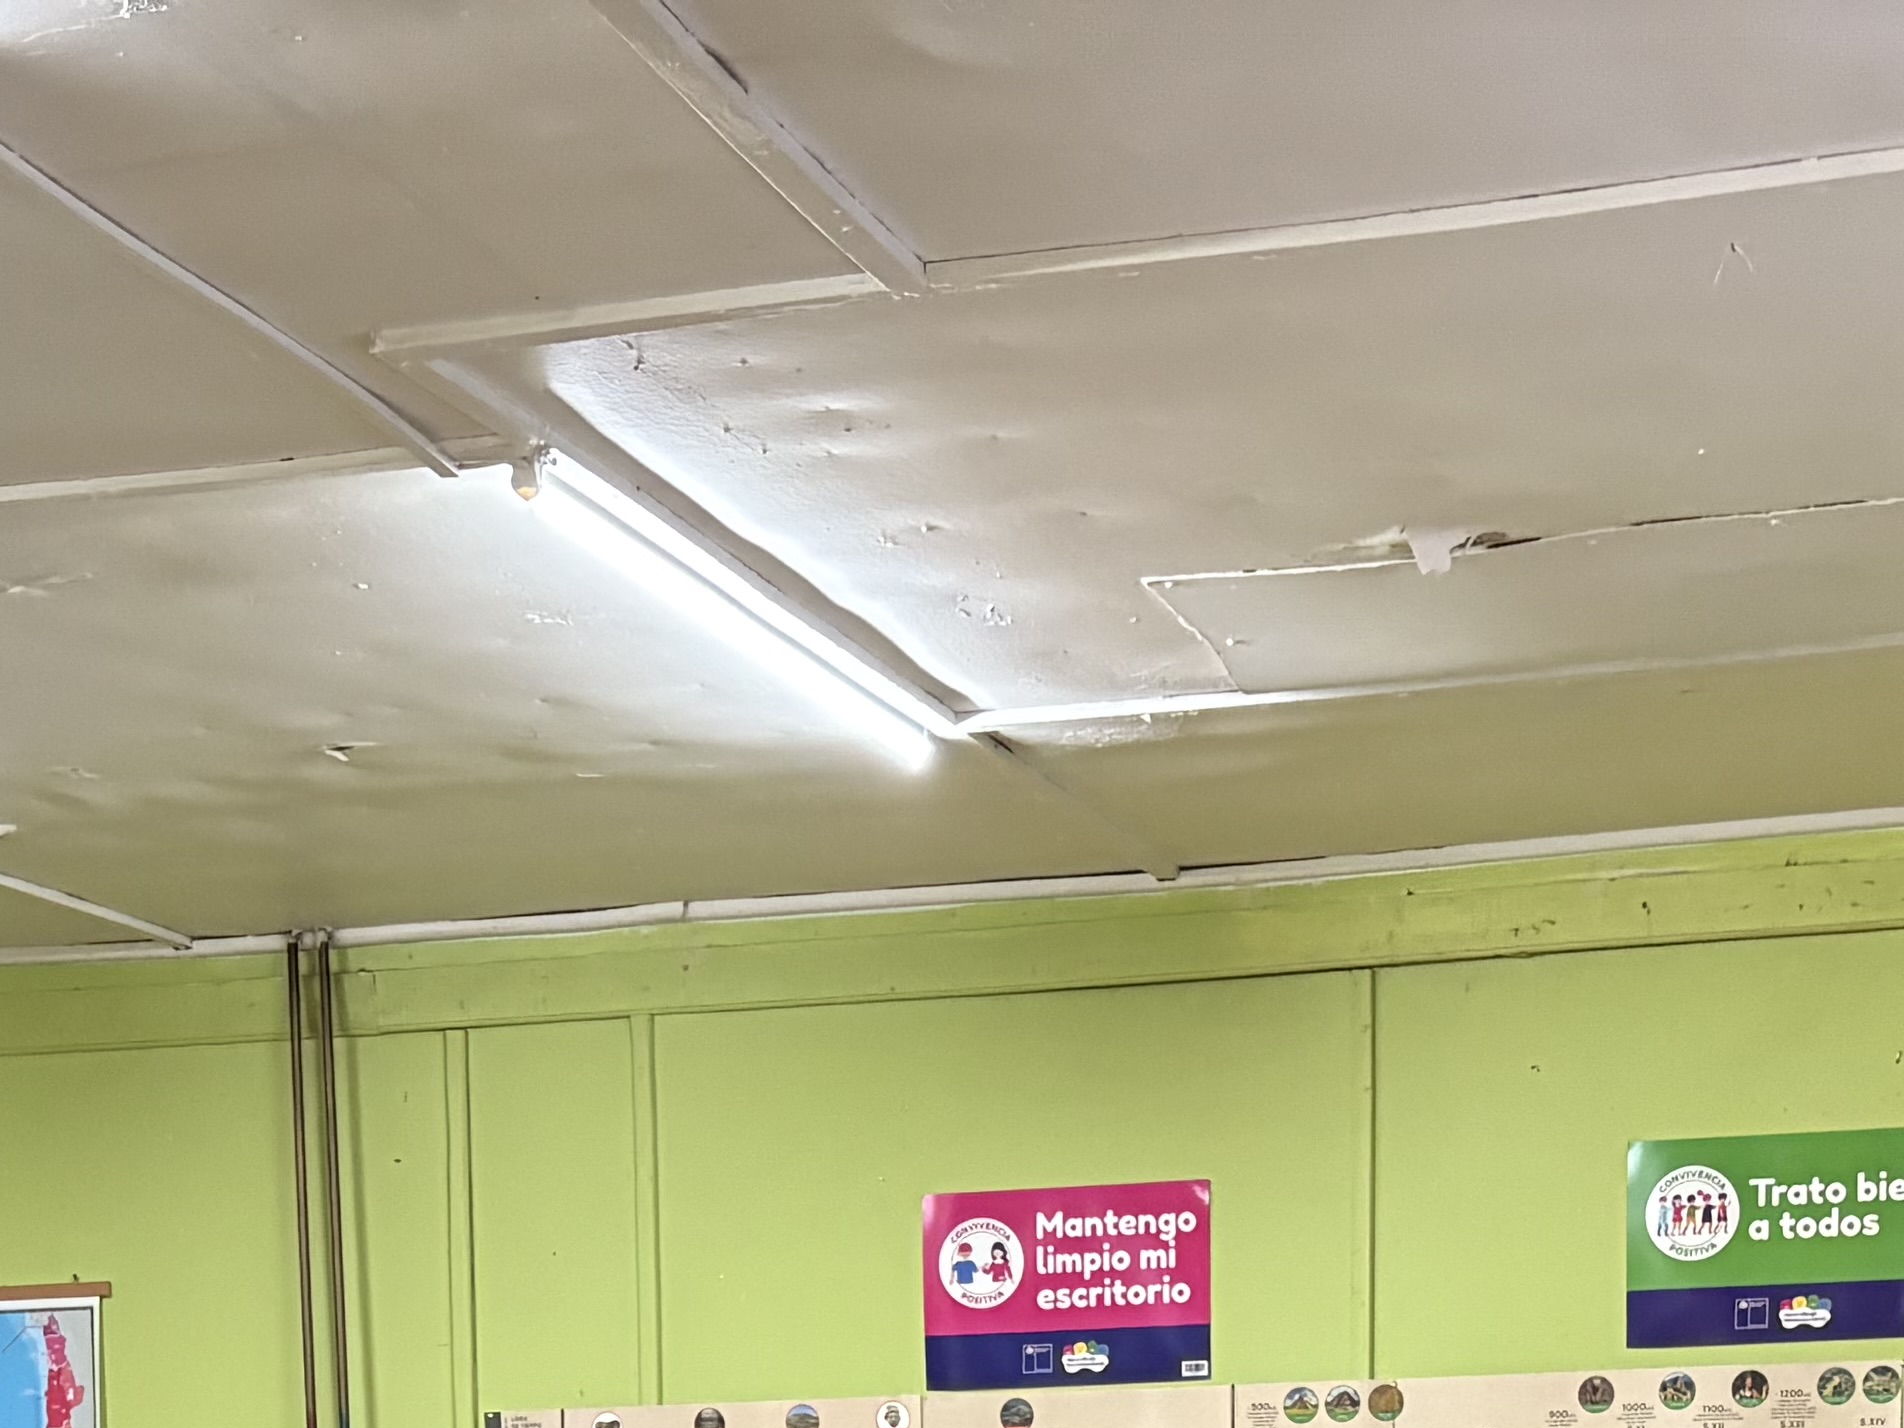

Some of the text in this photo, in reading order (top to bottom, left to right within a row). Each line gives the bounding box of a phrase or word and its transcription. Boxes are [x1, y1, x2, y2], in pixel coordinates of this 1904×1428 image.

[1659, 1170, 1725, 1193] CONVIVENCIA
[1749, 1176, 1847, 1208] Trato
[951, 1223, 1011, 1244] CONVIVENCIA
[1036, 1209, 1197, 1241] Mantengo
[1748, 1208, 1880, 1241] a todos
[1036, 1240, 1177, 1280] limpio mi
[1669, 1242, 1717, 1256] POSITIVA
[961, 1291, 1004, 1304] POSITIVA
[1036, 1278, 1191, 1310] escritorio
